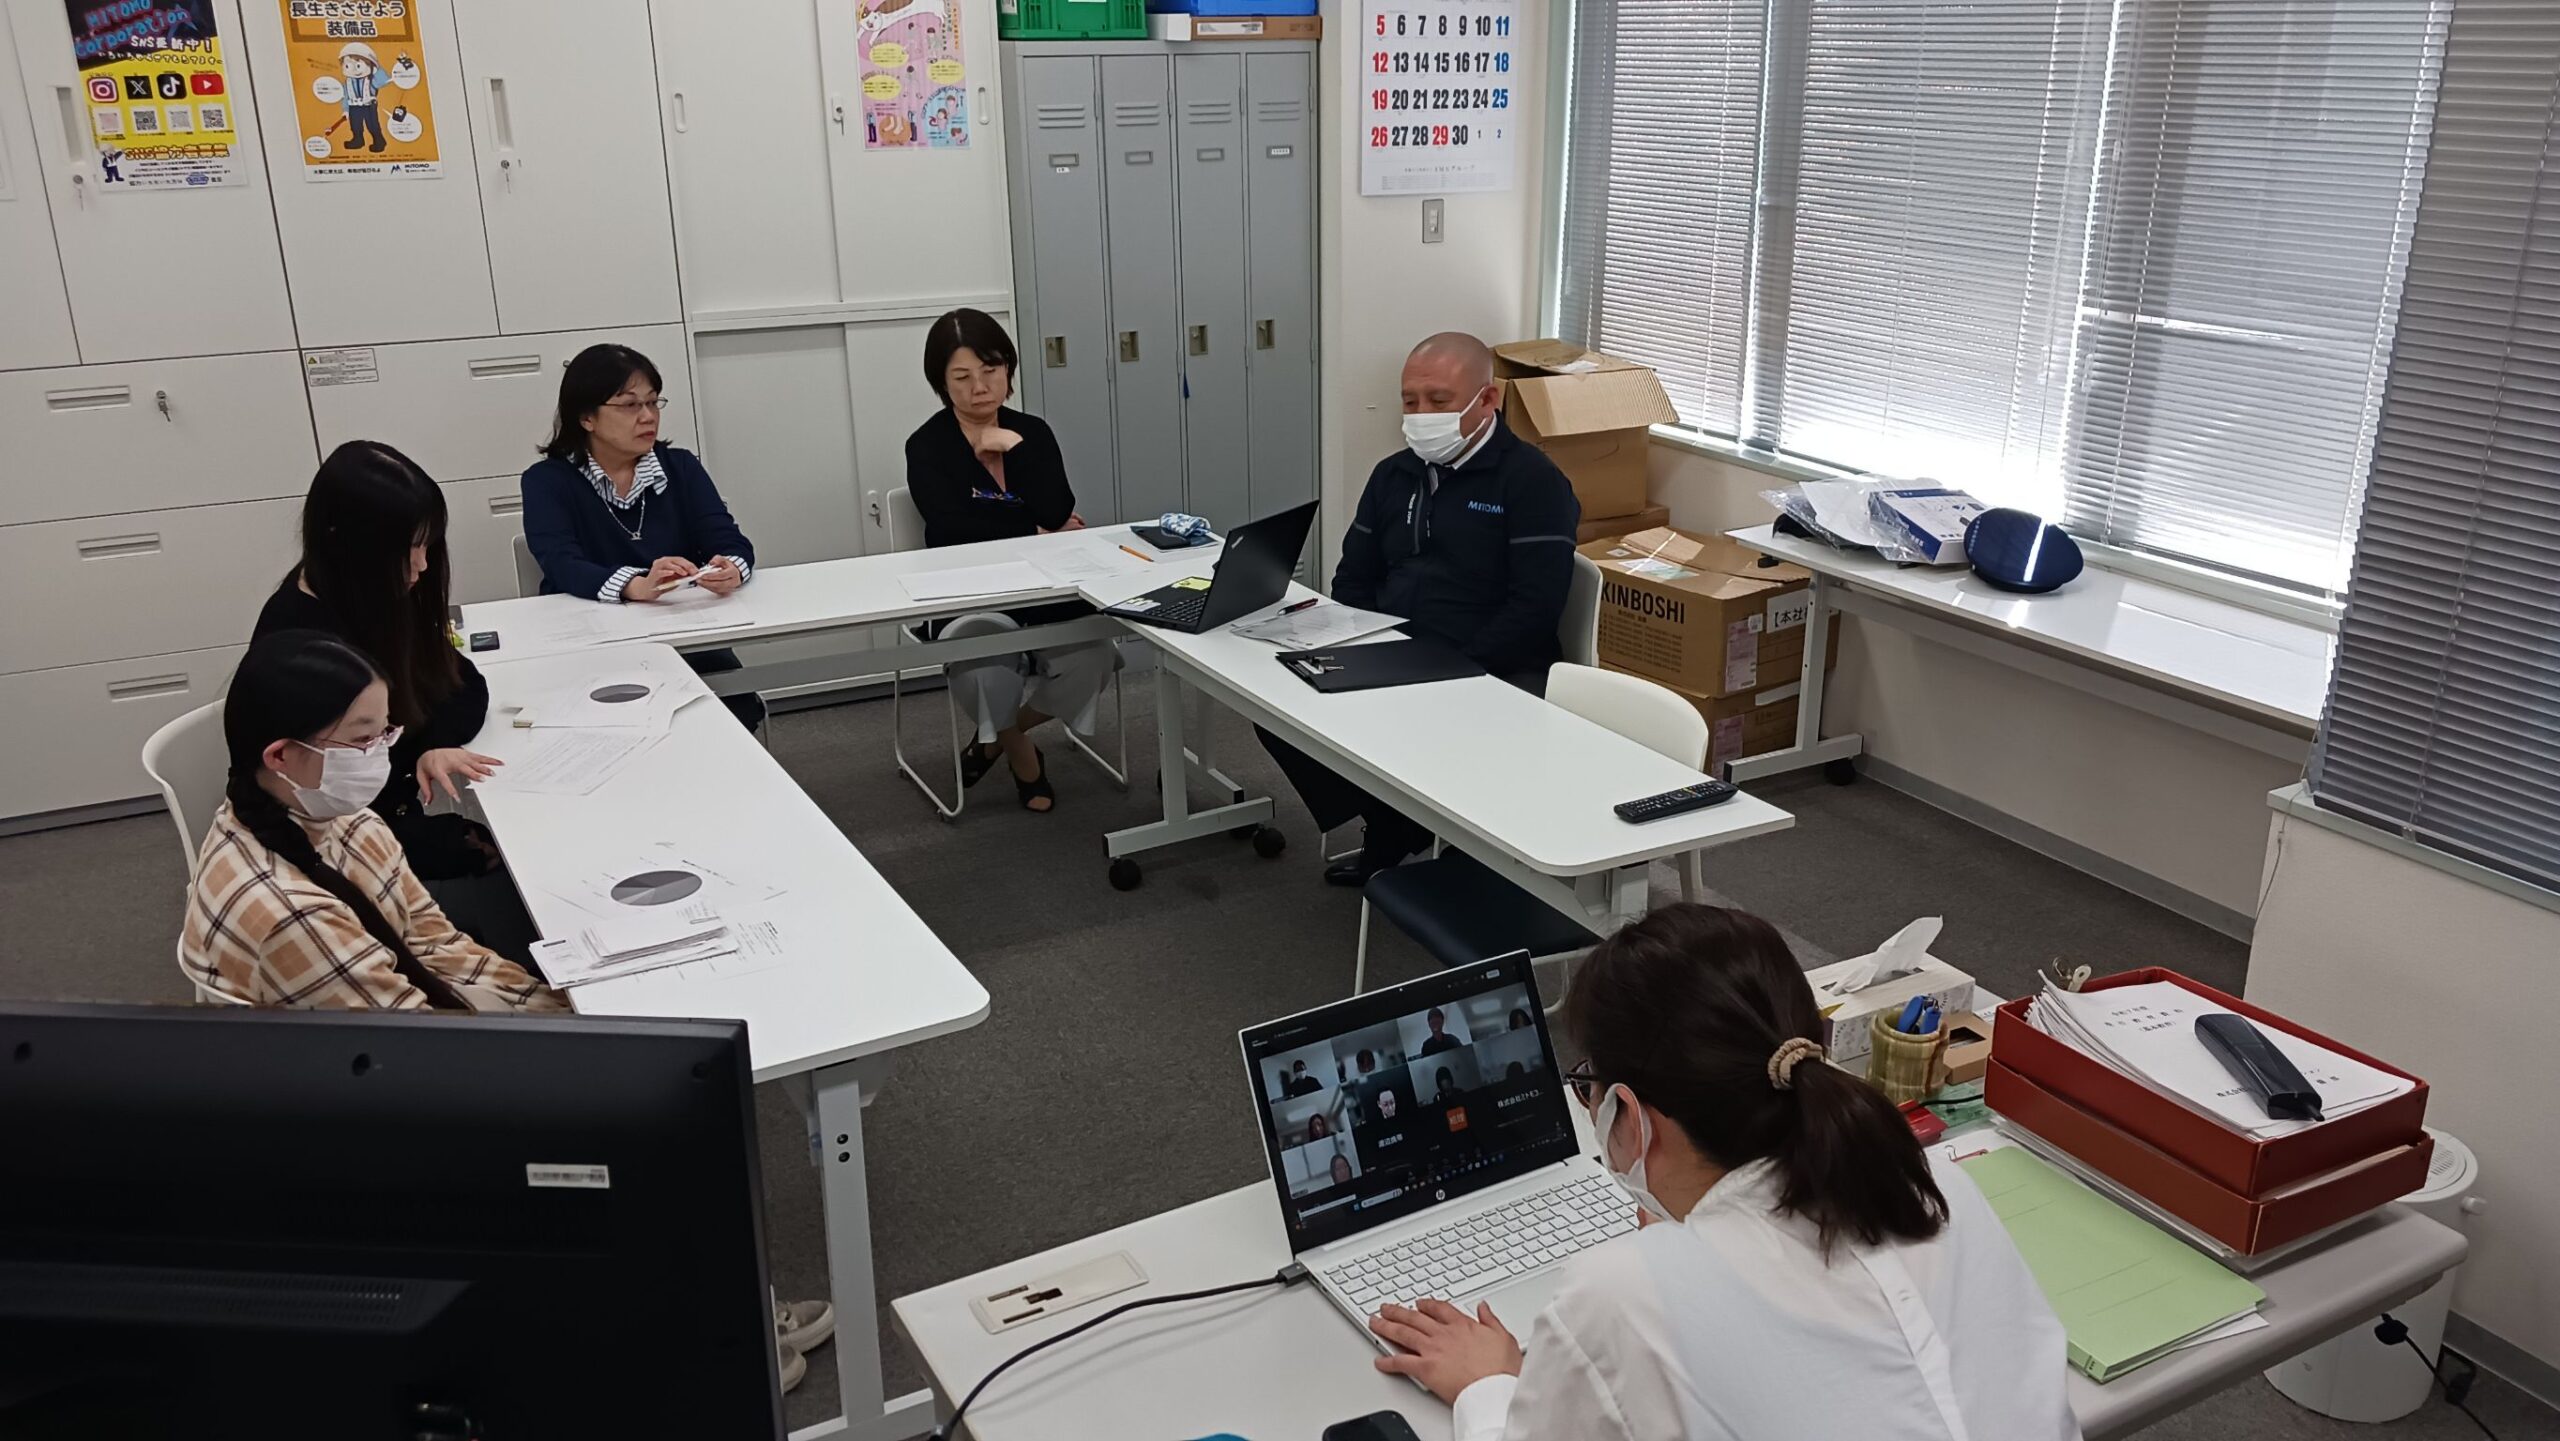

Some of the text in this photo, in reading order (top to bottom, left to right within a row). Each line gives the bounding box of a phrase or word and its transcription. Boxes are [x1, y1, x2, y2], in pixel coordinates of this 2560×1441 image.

[291, 2, 405, 17] 長生きさせよう
[327, 21, 376, 36] 装備品
[1377, 15, 1509, 36] 5 6 7 8 9 10 11
[1373, 52, 1509, 72] 12 13 14 15 16 17 18
[1372, 89, 1508, 110] 19 20 21 22 23 24 25
[1372, 127, 1387, 147] 26
[1392, 126, 1408, 146] 27
[1413, 126, 1428, 145] 28
[1433, 126, 1448, 145] 29
[1453, 125, 1468, 145] 30
[1601, 582, 1685, 624] KINBOSHI
